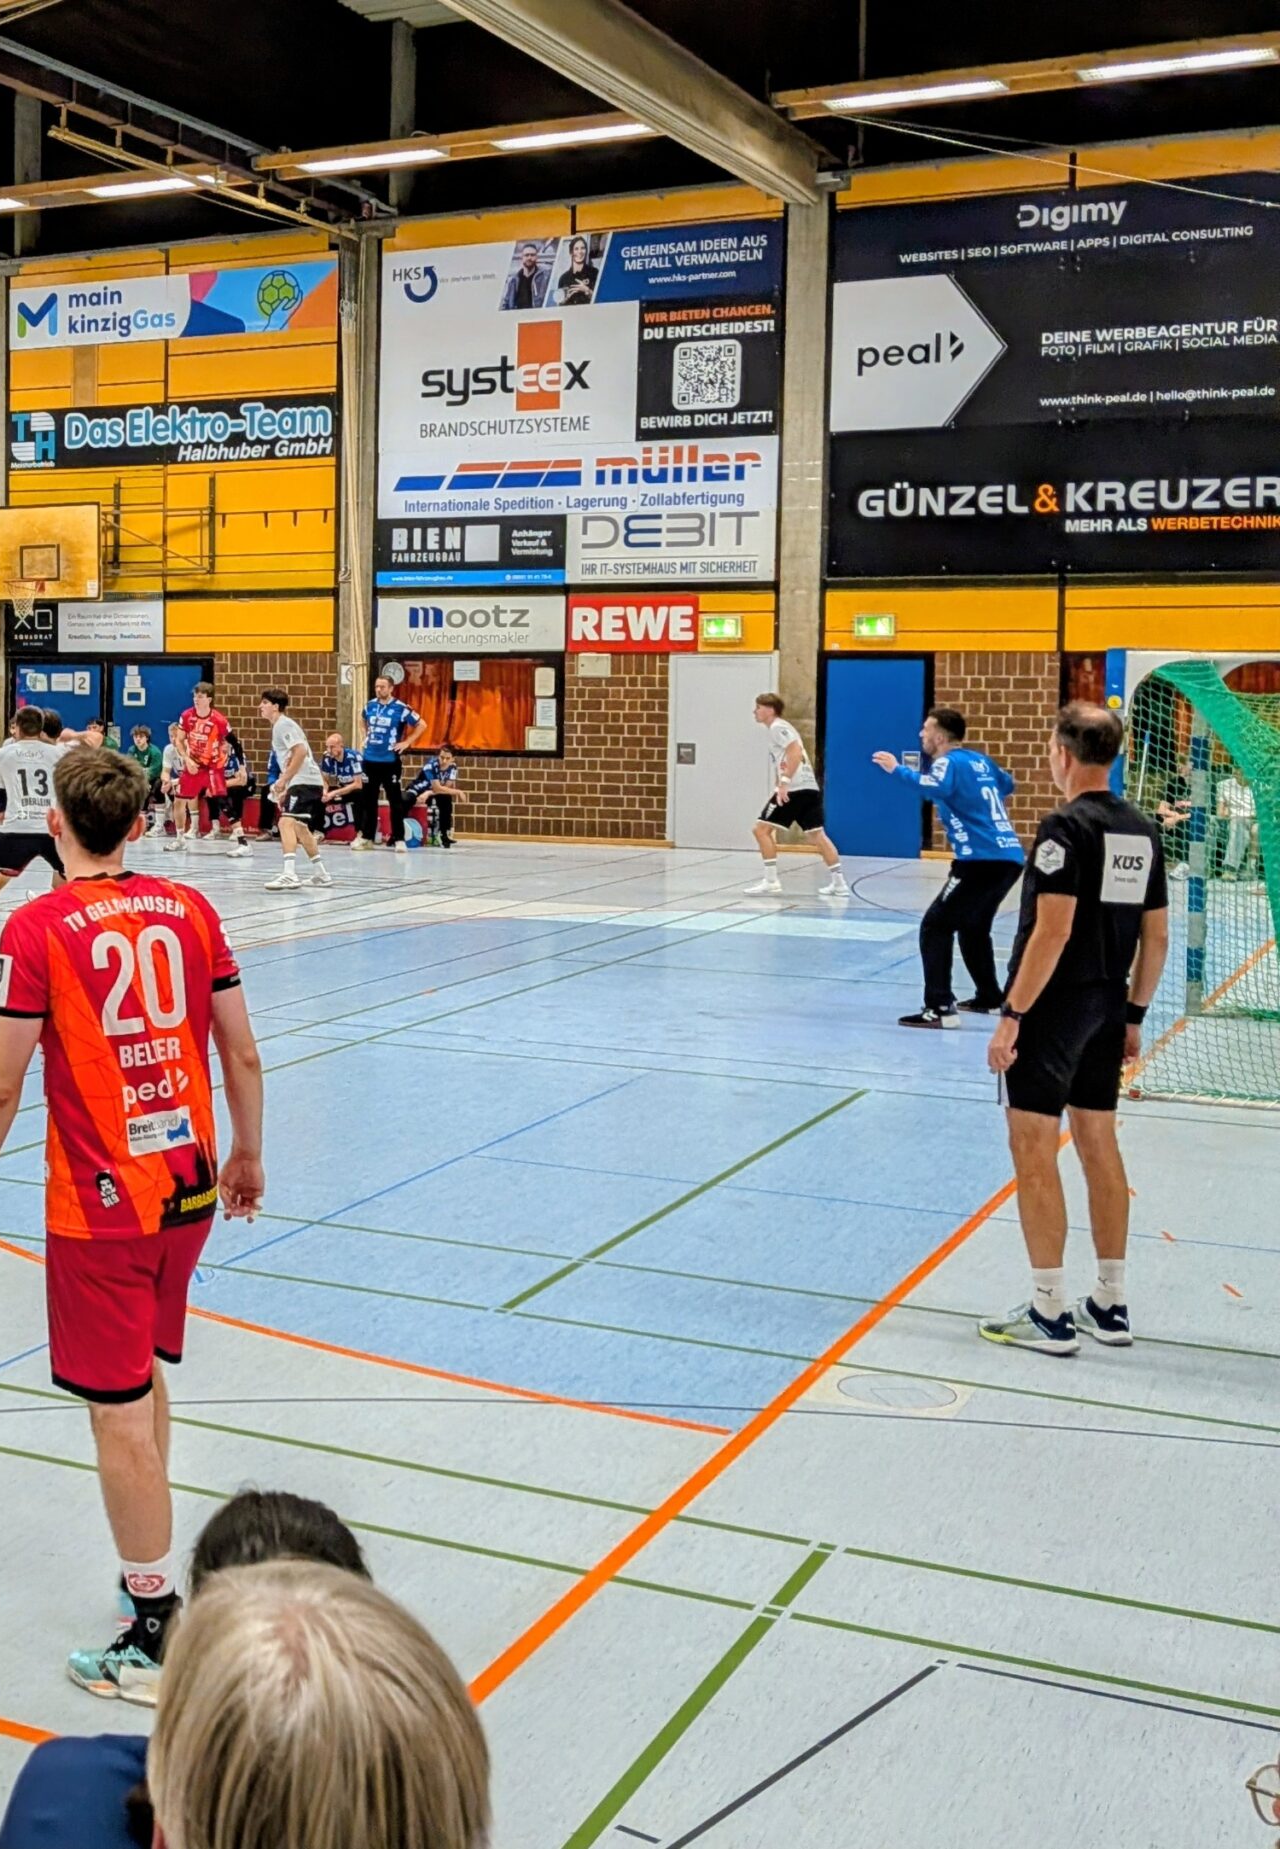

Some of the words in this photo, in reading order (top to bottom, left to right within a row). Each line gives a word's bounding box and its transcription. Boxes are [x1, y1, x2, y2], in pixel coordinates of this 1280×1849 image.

[621, 242, 697, 258] GEMEINSAM
[700, 237, 738, 253] IDEEN
[740, 234, 768, 249] AUS
[900, 248, 959, 264] WEBSITES
[967, 245, 991, 259] SEO
[1000, 239, 1068, 256] SOFTWARE
[1076, 236, 1110, 250] APPS
[1120, 230, 1169, 246] DIGITAL
[1171, 225, 1254, 242] CONSULTING
[624, 256, 671, 271] METALL
[675, 248, 763, 267] VERWANDELN
[393, 266, 422, 282] HKS
[648, 268, 737, 286] www.hks-partner.com
[68, 286, 122, 308] main
[68, 309, 176, 338] kinzigGas
[644, 310, 668, 324] WIR
[669, 307, 710, 322] BIETEN
[712, 303, 776, 319] CHANCEN.
[643, 326, 664, 340] DU
[666, 319, 776, 339] ENTSCHEIDEST!
[1041, 328, 1092, 346] DEINE
[1095, 320, 1239, 341] WERBEAGENTUR
[1243, 316, 1278, 334] FÜR
[857, 332, 942, 376] peal
[1041, 343, 1076, 356] FOTO
[1085, 340, 1115, 354] FILM
[1124, 337, 1172, 353] GRAFIK
[1182, 334, 1229, 350] SOCIAL
[1233, 331, 1277, 347] MEDIA
[1040, 392, 1148, 407] www.think-peal.de
[1156, 385, 1276, 403] hello@think-peal.de
[64, 412, 124, 449] Das
[126, 402, 331, 447] Elektro-Team
[420, 415, 591, 439] BRANDSCHUTZSYSTEME
[640, 415, 692, 430] BEWIRB
[694, 412, 727, 427] DICH
[730, 409, 774, 426] JETZT!
[177, 443, 271, 463] Halbhuber
[275, 438, 333, 458] GmbH
[594, 444, 762, 486] müller
[404, 497, 490, 513] Internationale
[494, 496, 554, 514] Spedition
[566, 494, 628, 511] Lagerung
[640, 491, 746, 508] Zollabfertigung
[857, 481, 1029, 518] GÜNZEL
[1034, 483, 1060, 513] &
[1065, 476, 1280, 513] KREUZER
[1065, 518, 1112, 532] MEHR
[1116, 517, 1148, 531] ALS
[1151, 515, 1280, 531] WERBETECHNIK
[392, 526, 461, 550] BIEN
[392, 551, 461, 563] FAHRZEUGBAU
[581, 561, 597, 575] IHR
[600, 560, 677, 576] IT-SYSTEMHAUS
[679, 560, 697, 574] MIT
[699, 558, 758, 574] SICHERHEIT
[409, 604, 530, 628] mootz
[571, 605, 695, 641] REWE
[408, 631, 529, 647] Versicherungsmakler
[78, 676, 86, 690] 2
[17, 768, 49, 797] 13
[63, 911, 87, 932] TV
[91, 924, 186, 1037] 20
